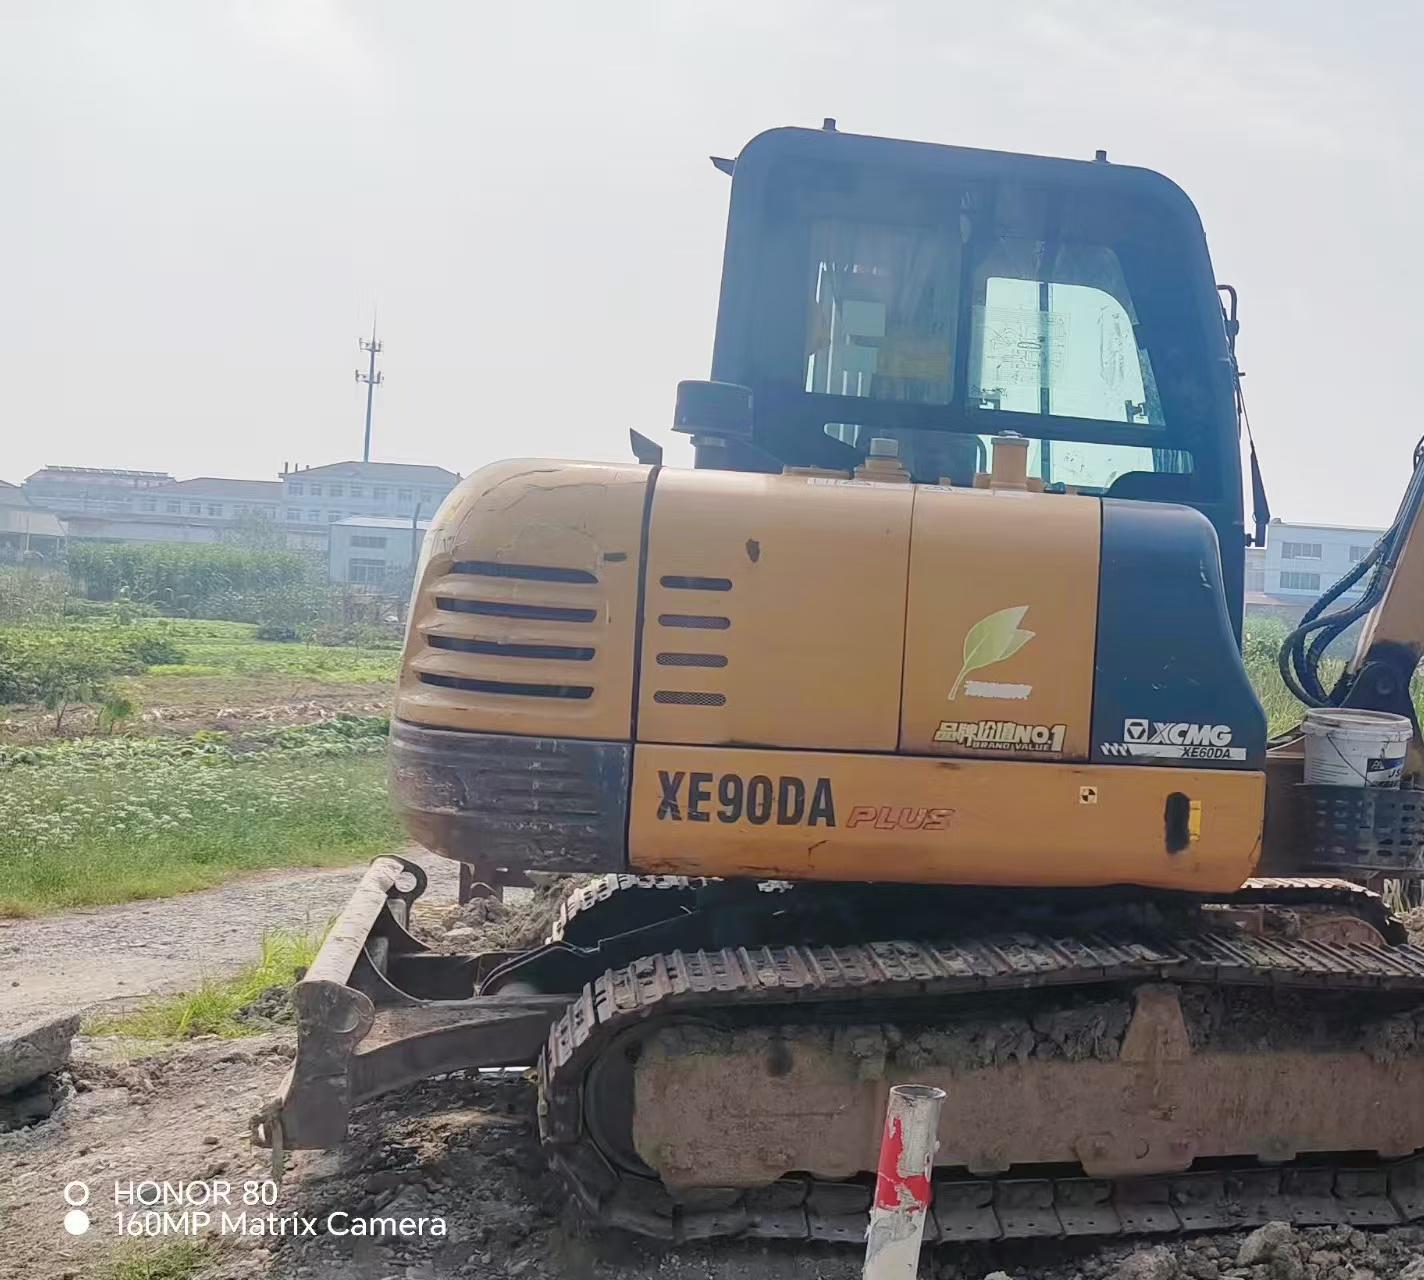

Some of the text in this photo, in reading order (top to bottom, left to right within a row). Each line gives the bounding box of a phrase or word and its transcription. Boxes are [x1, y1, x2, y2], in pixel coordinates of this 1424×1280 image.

[1148, 722, 1233, 747] XCMG
[972, 741, 1052, 752] BRAND VALUE
[1181, 746, 1231, 759] XE60DA
[656, 770, 956, 831] XE90DA PLUS
